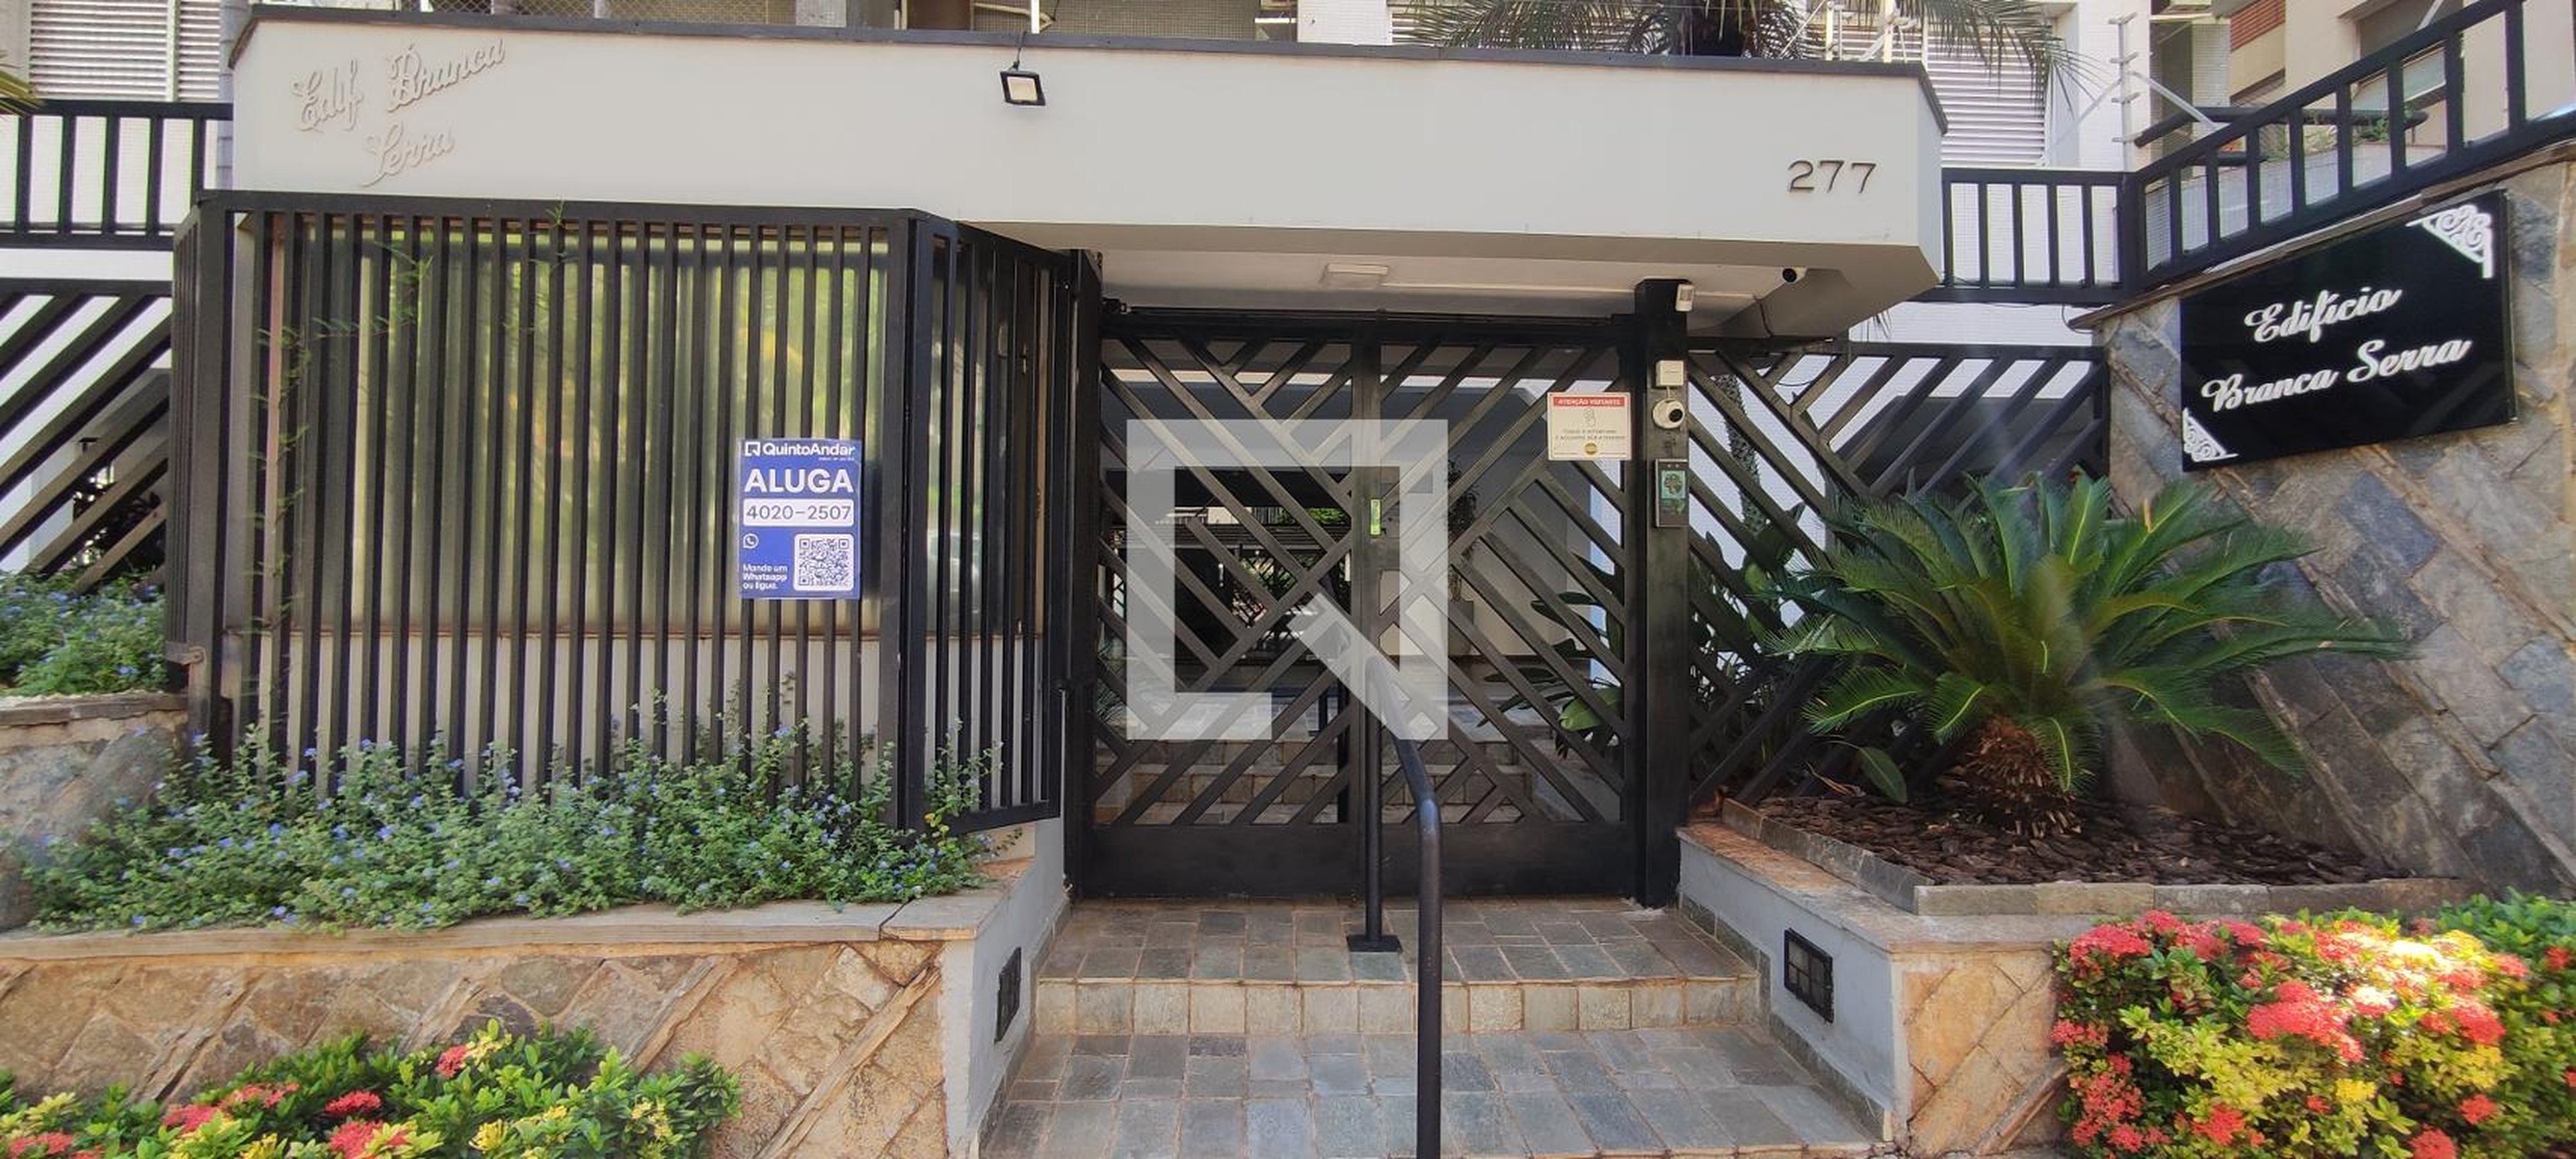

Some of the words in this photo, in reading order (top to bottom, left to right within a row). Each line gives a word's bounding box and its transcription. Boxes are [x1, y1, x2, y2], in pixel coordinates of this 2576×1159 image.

[386, 39, 506, 113] Branca
[362, 120, 455, 188] Serra
[1788, 160, 1877, 194] 277
[2244, 286, 2403, 343] Edifício
[2201, 367, 2339, 412] Branca
[2347, 338, 2473, 383] Serra
[762, 442, 855, 456] QuintoAndar
[744, 468, 854, 493] ALUGA
[746, 505, 852, 520] 4020-2507
[743, 564, 772, 572] Mande
